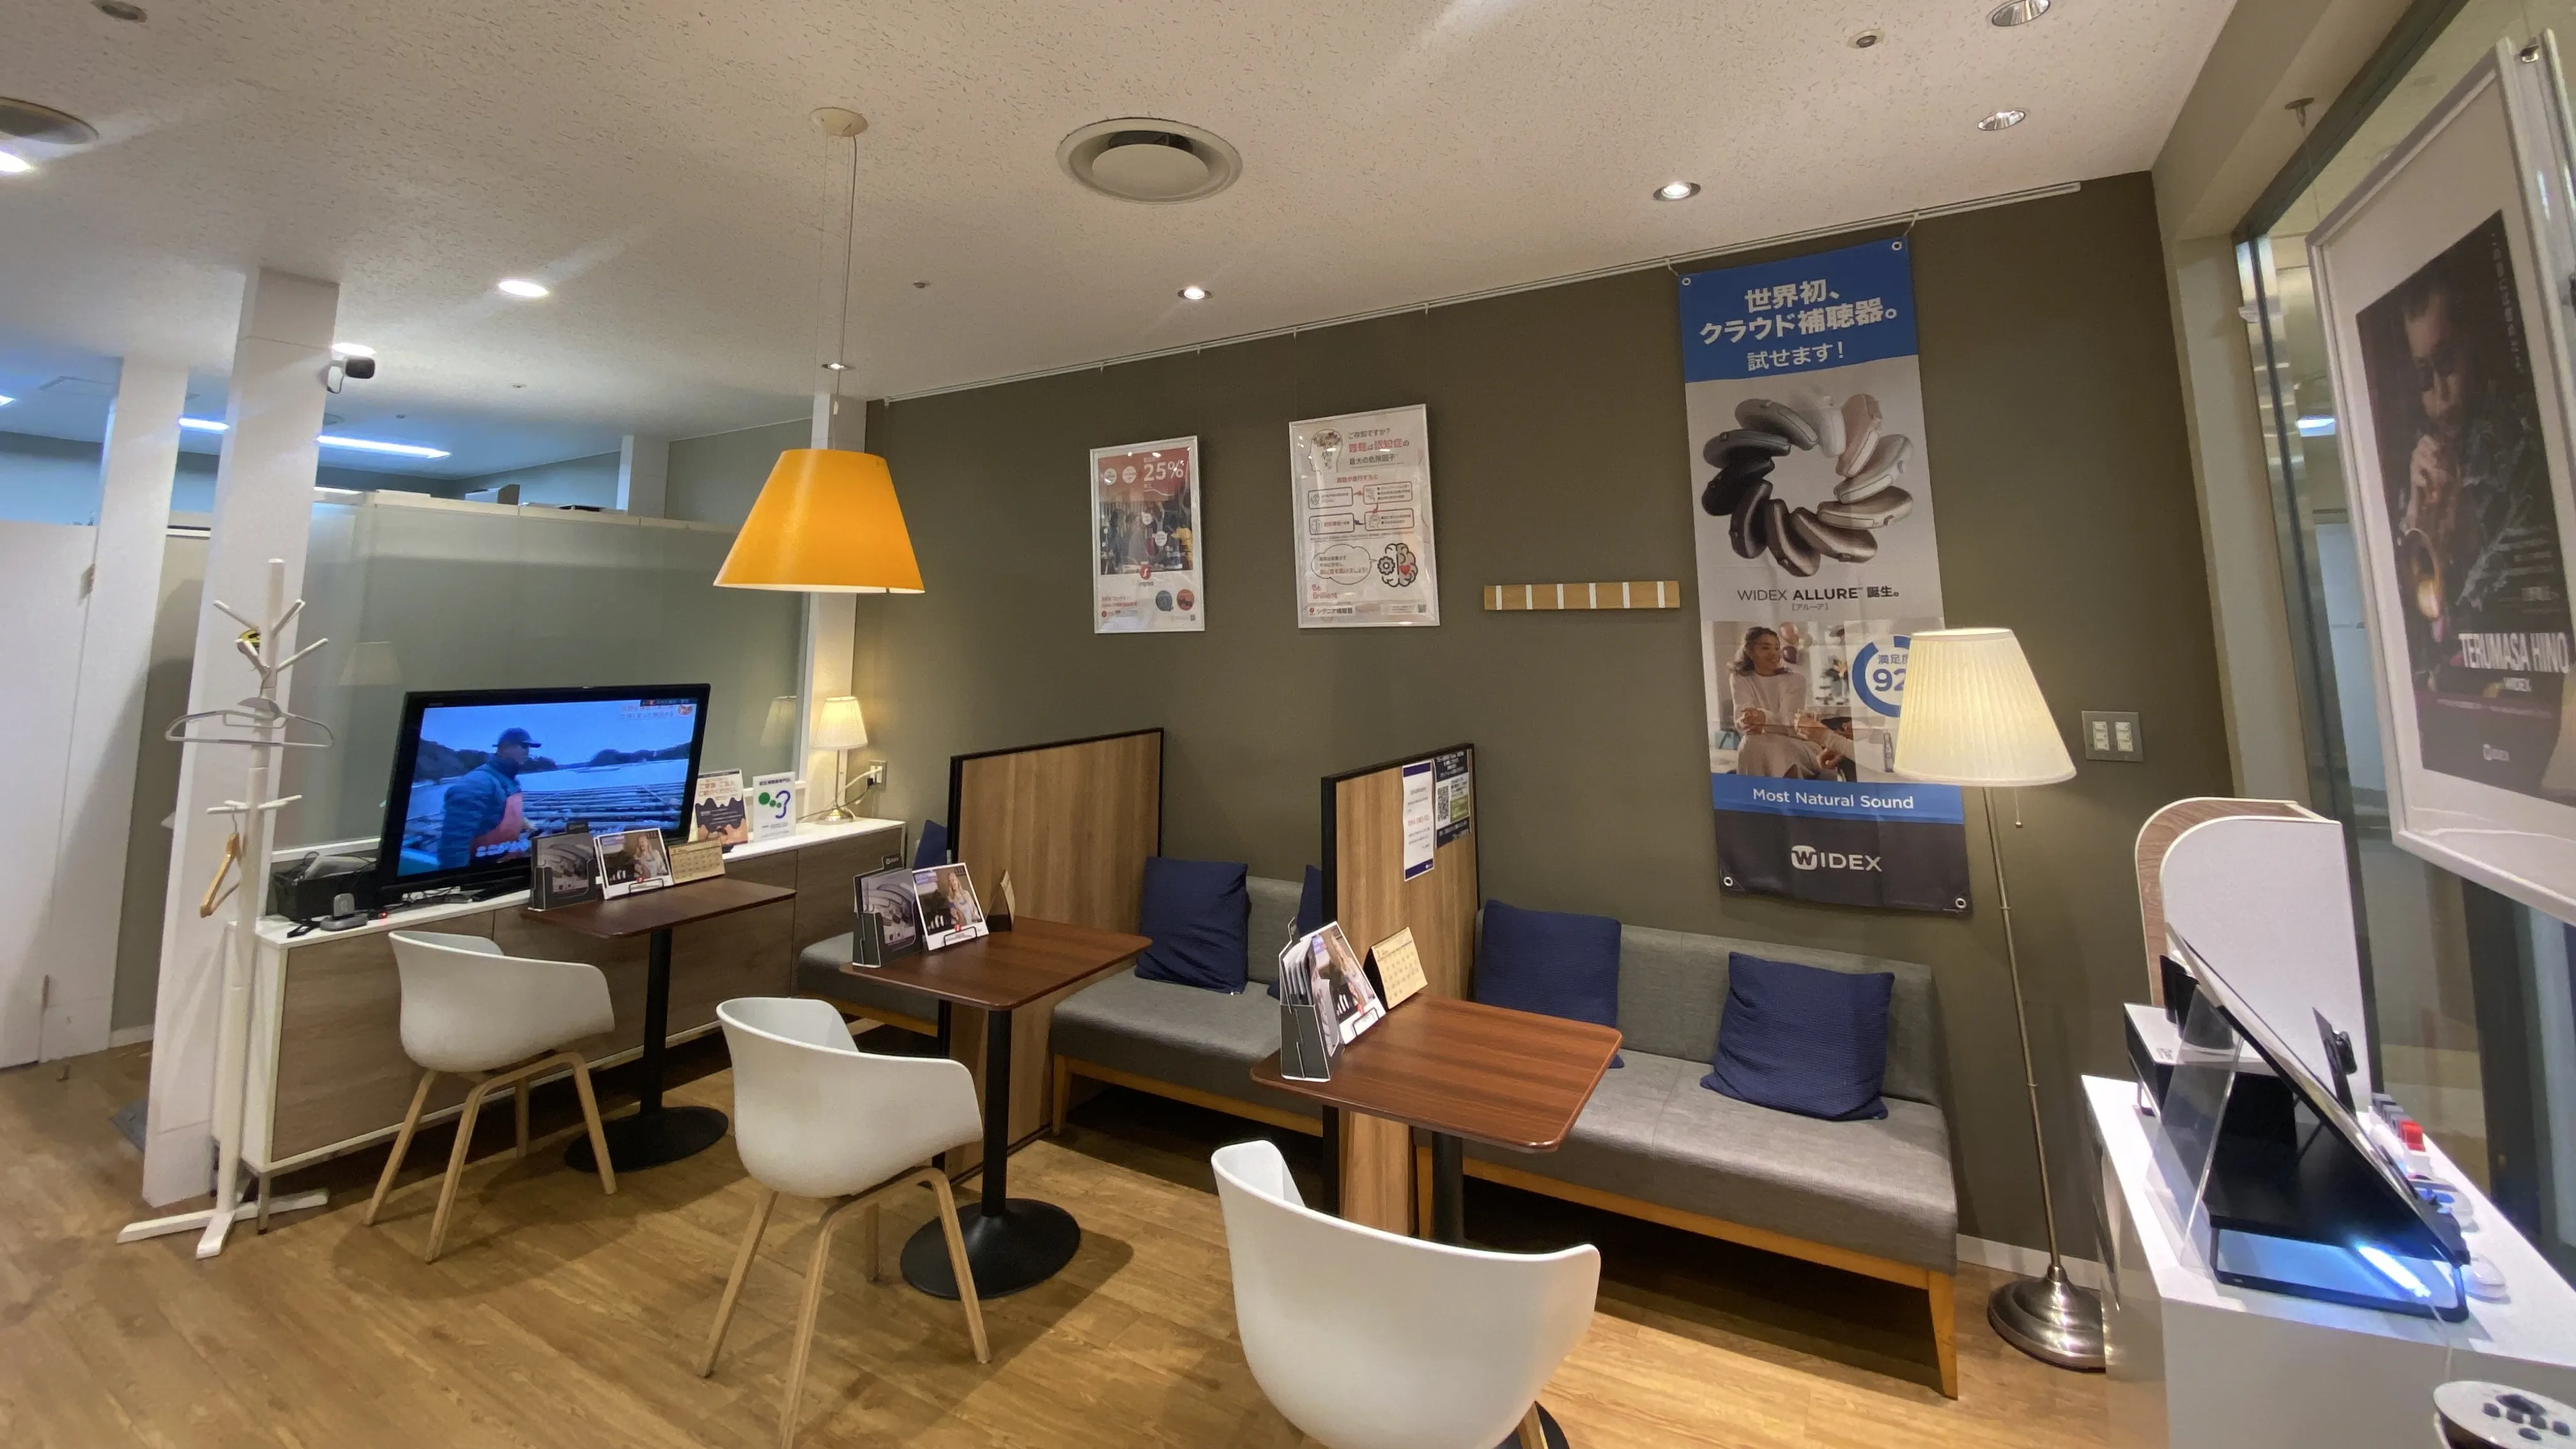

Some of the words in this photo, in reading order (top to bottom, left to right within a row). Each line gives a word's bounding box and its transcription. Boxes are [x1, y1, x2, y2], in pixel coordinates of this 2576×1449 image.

[1744, 279, 1840, 314] 世界初、
[1699, 296, 1897, 345] クラウド補聴器。
[1143, 459, 1184, 482] 25%
[1737, 589, 1788, 601] WIDEX
[2458, 632, 2531, 671] TERUMASA
[2530, 632, 2570, 674] HINO
[1752, 788, 1790, 803] Most
[1795, 792, 1855, 808] Natural
[1860, 795, 1914, 809] Sound
[1791, 845, 1883, 873] WIDEX
